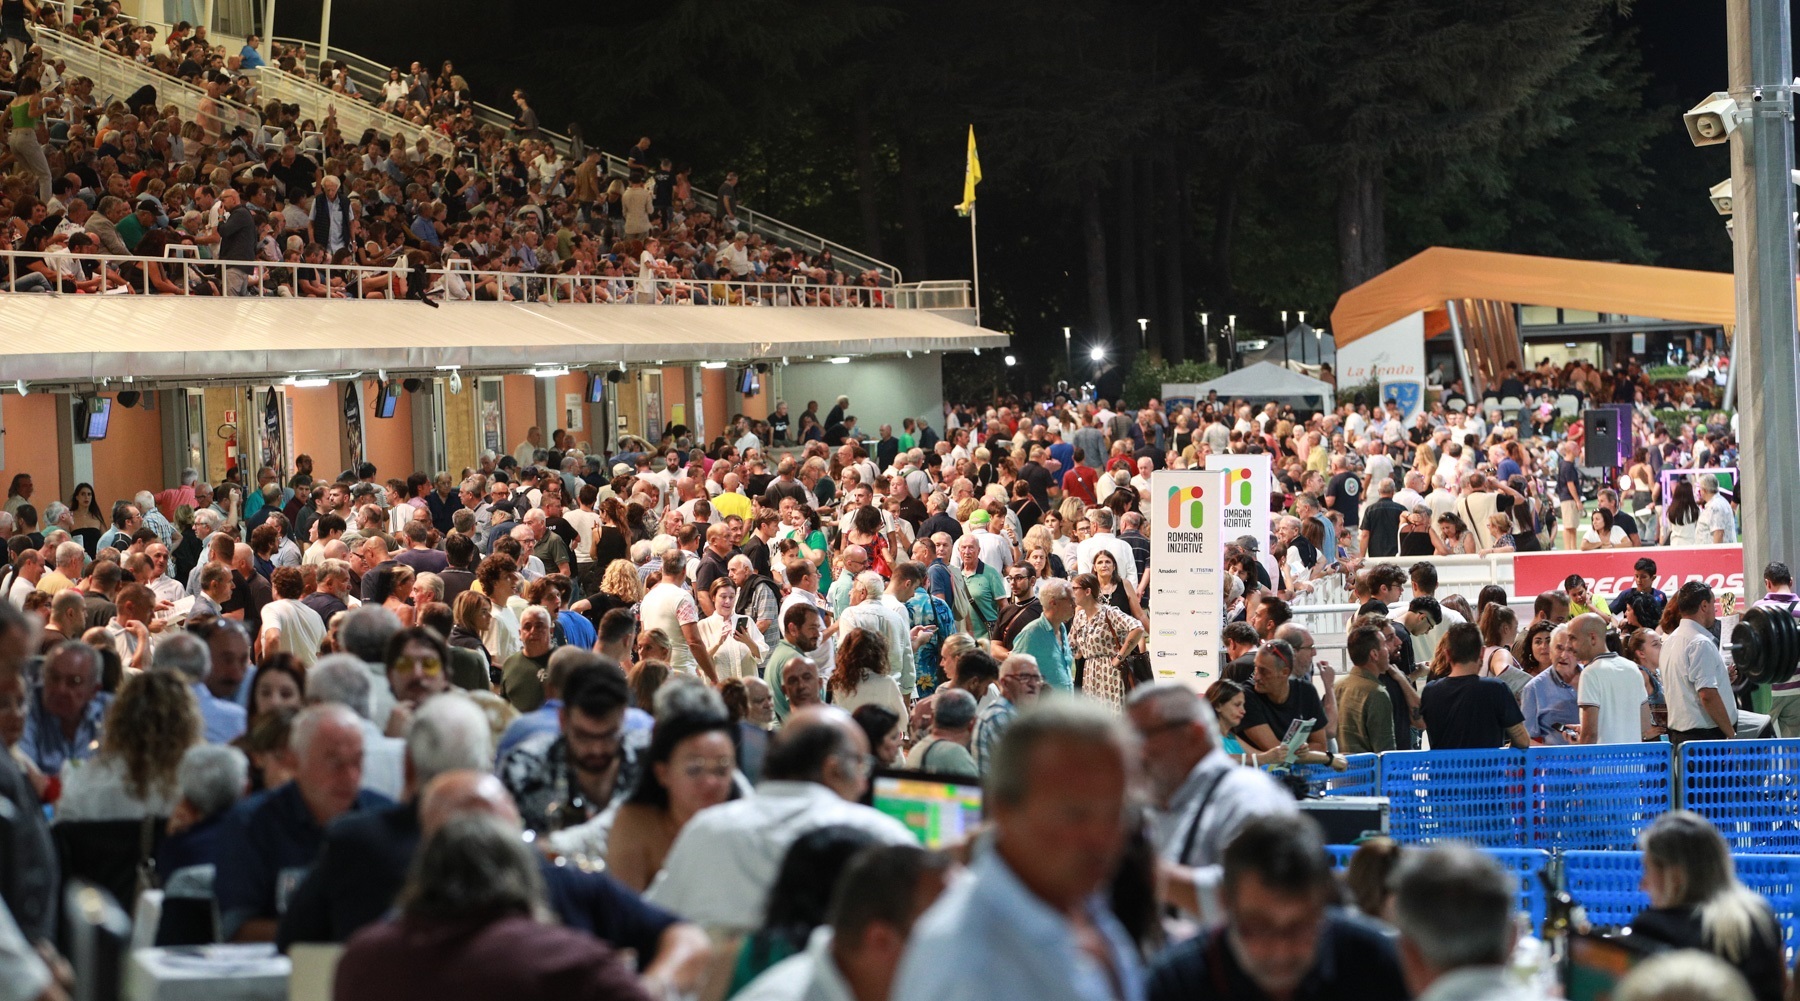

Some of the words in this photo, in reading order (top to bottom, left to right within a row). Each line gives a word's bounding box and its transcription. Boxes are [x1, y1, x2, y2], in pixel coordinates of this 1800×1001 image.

[1347, 366, 1364, 377] La
[1223, 508, 1252, 518] OMAGNA
[1167, 532, 1203, 542] ROMAGNA
[1167, 542, 1203, 553] INIZIATIVE
